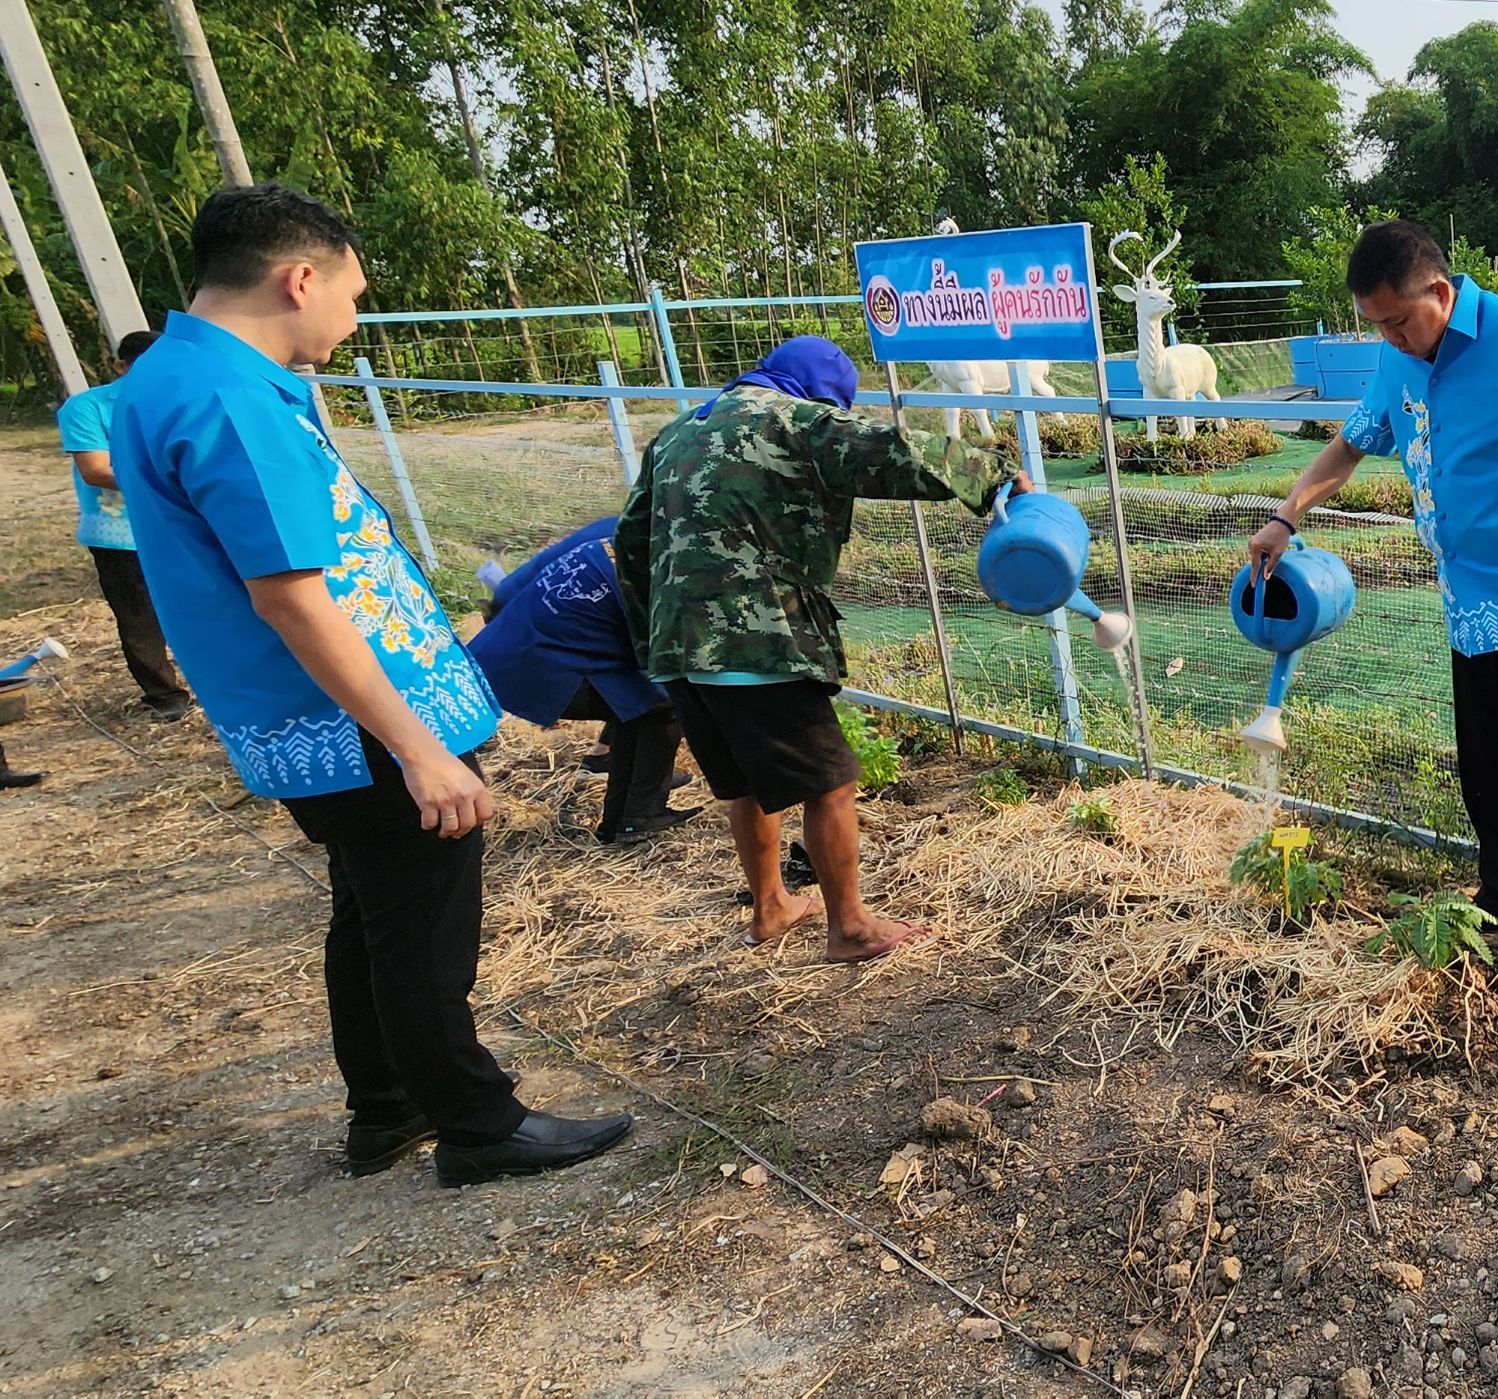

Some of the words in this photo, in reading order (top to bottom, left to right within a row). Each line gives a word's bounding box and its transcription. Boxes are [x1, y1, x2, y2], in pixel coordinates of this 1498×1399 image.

[903, 263, 988, 322] ทางนี้มีผล
[990, 269, 1087, 334] ผู้คนรักกัน
